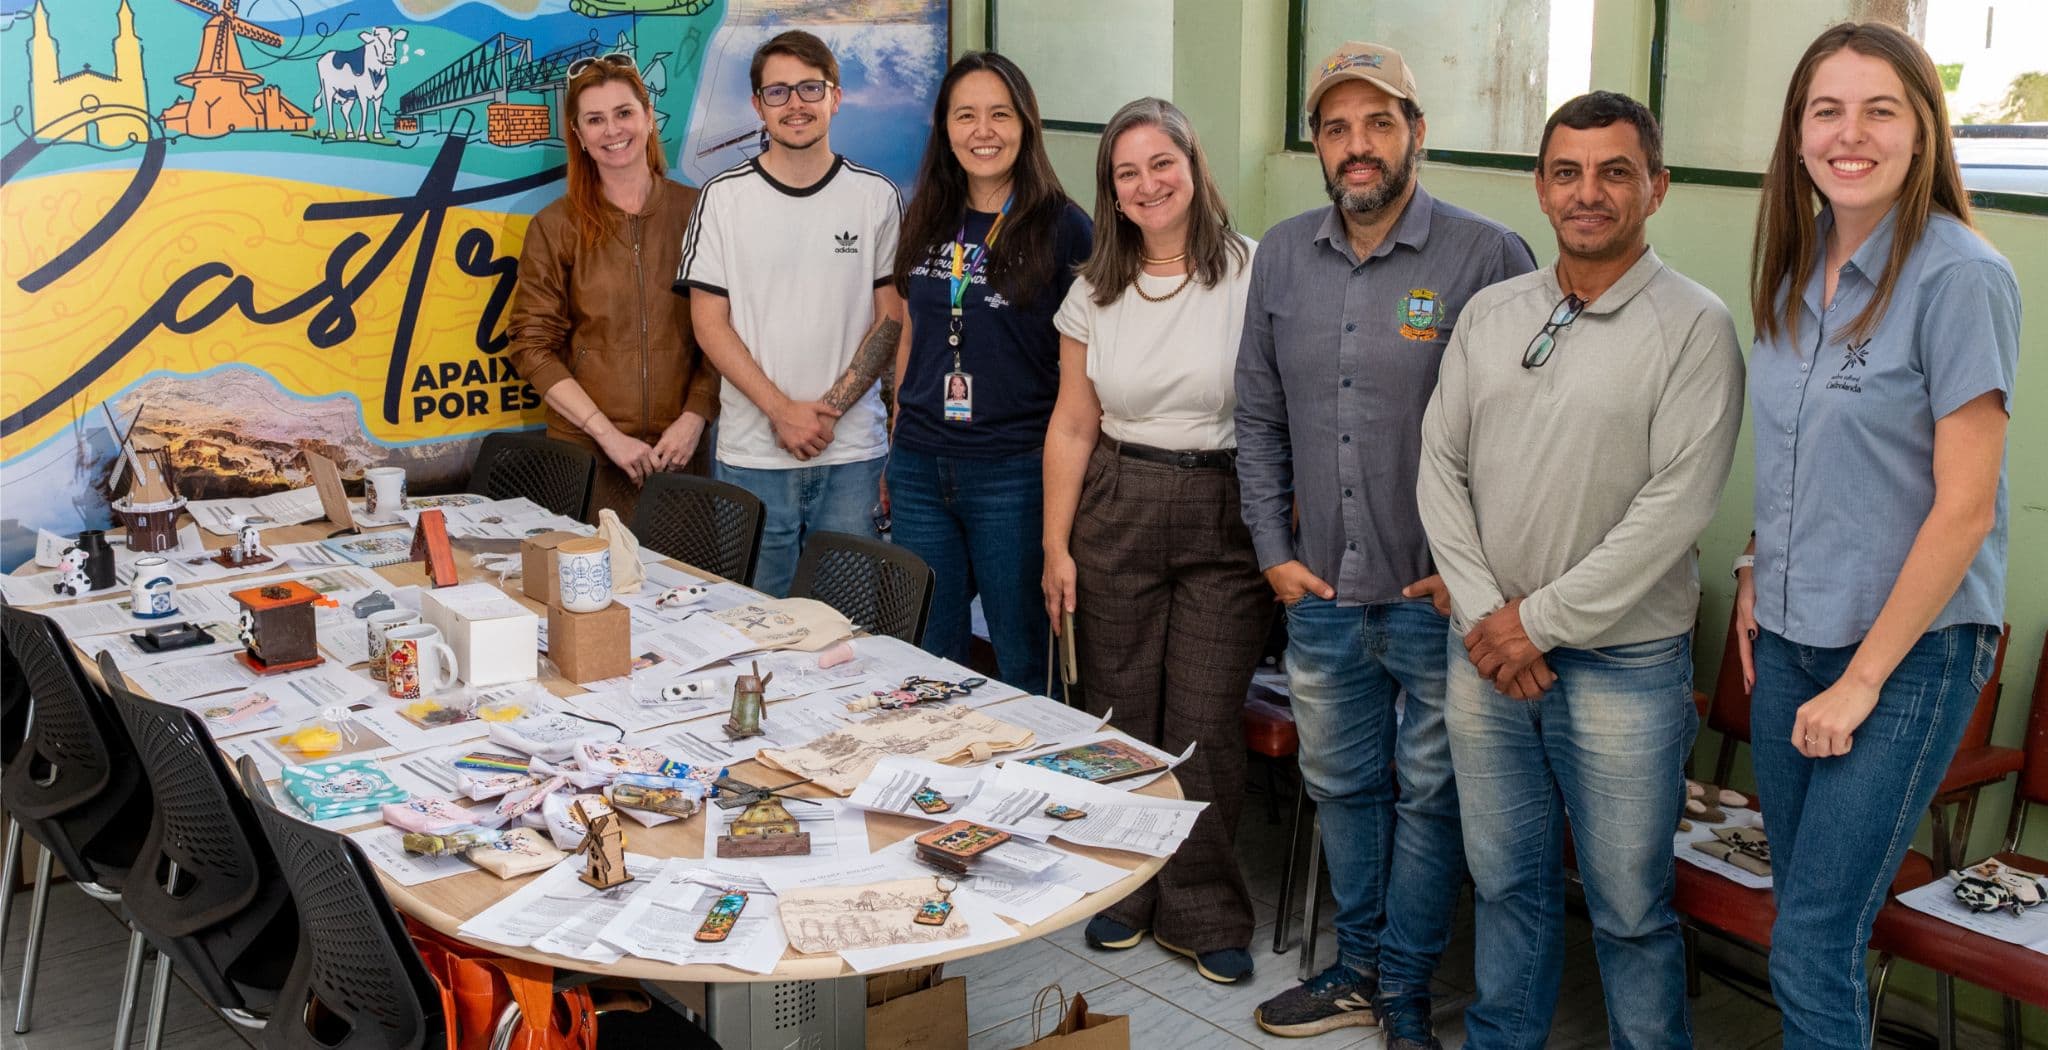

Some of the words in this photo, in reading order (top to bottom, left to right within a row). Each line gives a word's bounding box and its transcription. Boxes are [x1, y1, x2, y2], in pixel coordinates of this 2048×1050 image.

[0, 108, 567, 438] Castr
[411, 356, 521, 393] APAIX
[413, 389, 490, 423] POR
[500, 383, 542, 412] ES
